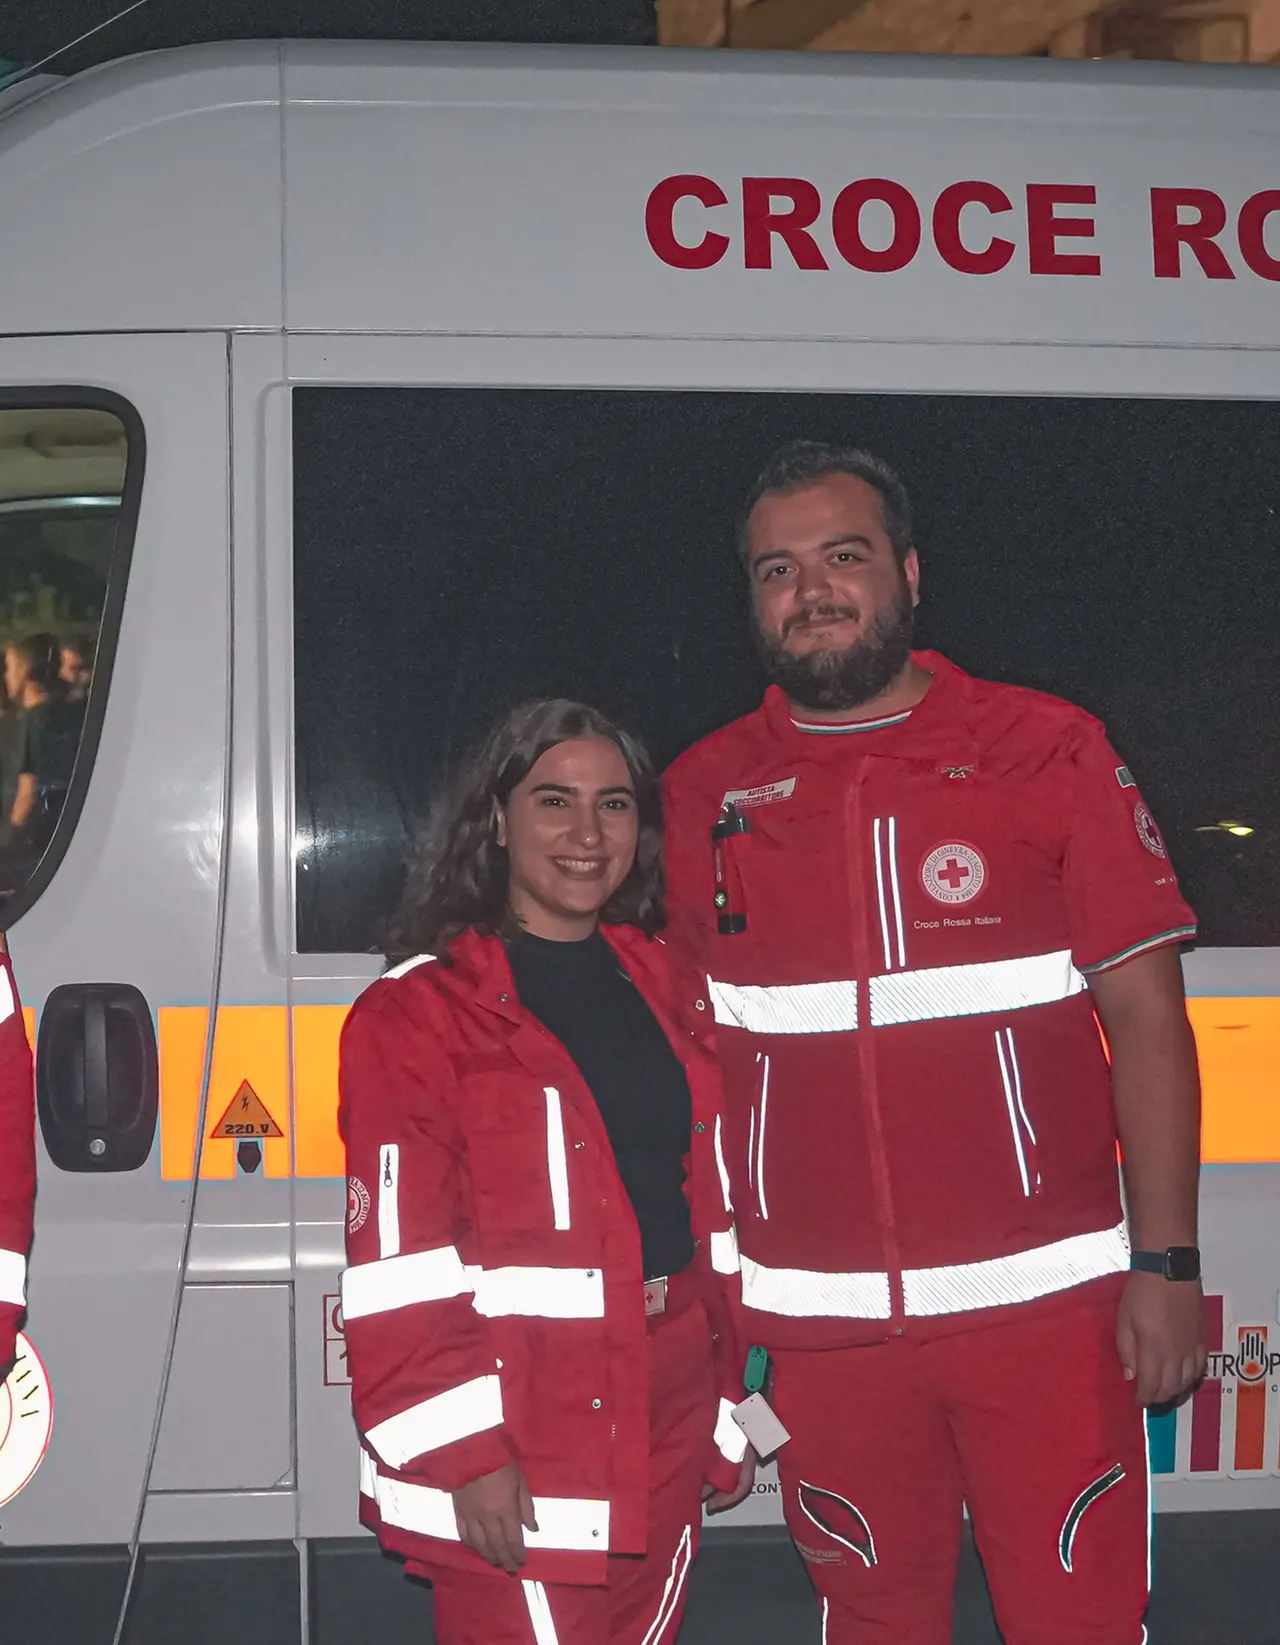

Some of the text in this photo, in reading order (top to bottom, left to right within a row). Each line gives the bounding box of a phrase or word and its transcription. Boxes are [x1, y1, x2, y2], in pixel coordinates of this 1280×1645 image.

[645, 174, 1102, 275] CROCE
[914, 920, 939, 929] Croce
[943, 918, 971, 927] Rossa
[224, 1123, 269, 1134] 220.V
